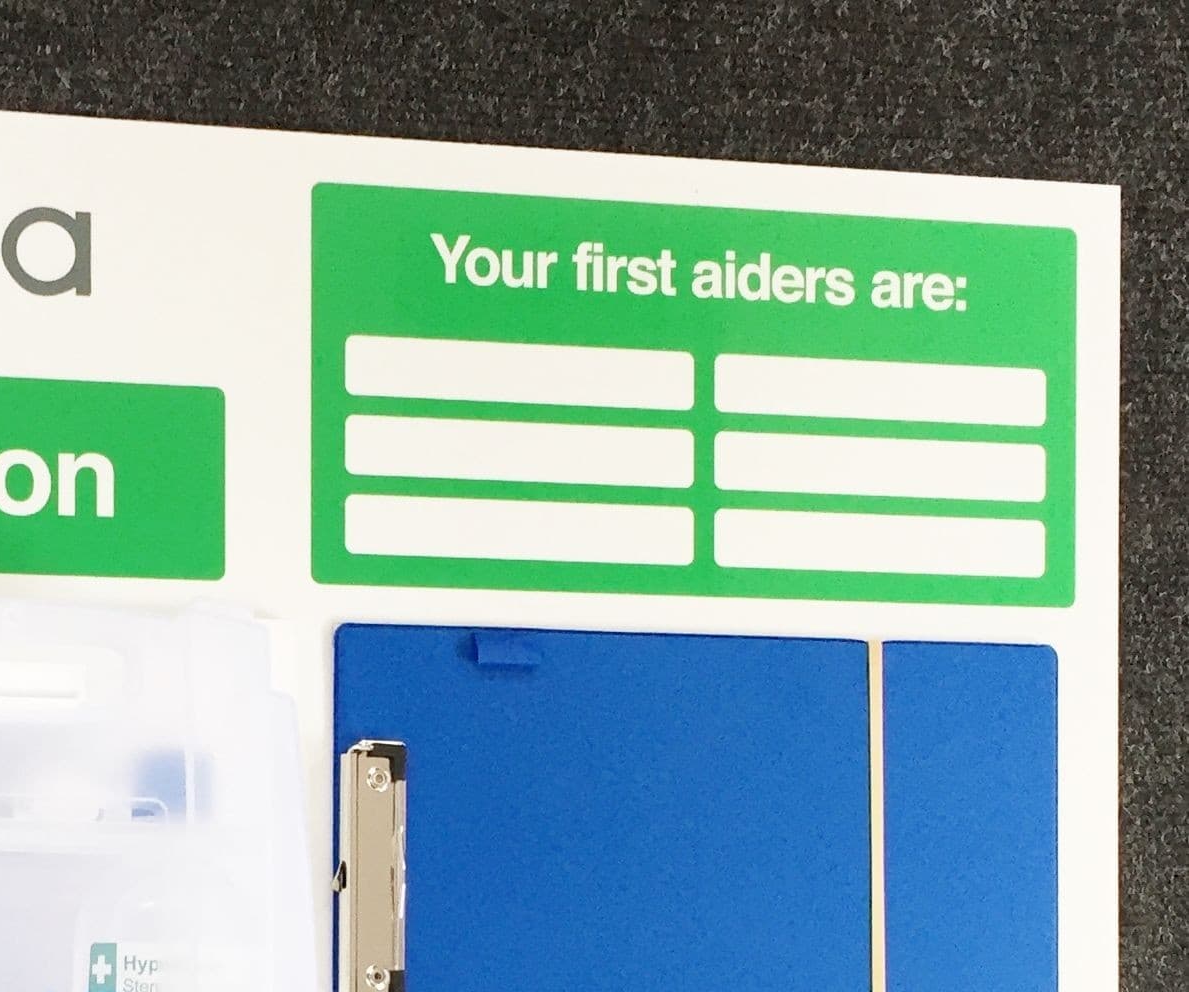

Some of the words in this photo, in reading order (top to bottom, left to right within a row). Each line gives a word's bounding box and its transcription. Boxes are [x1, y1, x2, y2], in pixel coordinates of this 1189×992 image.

[430, 232, 558, 289] Your
[572, 241, 677, 297] first
[692, 252, 855, 305] aiders
[871, 269, 968, 311] are:
